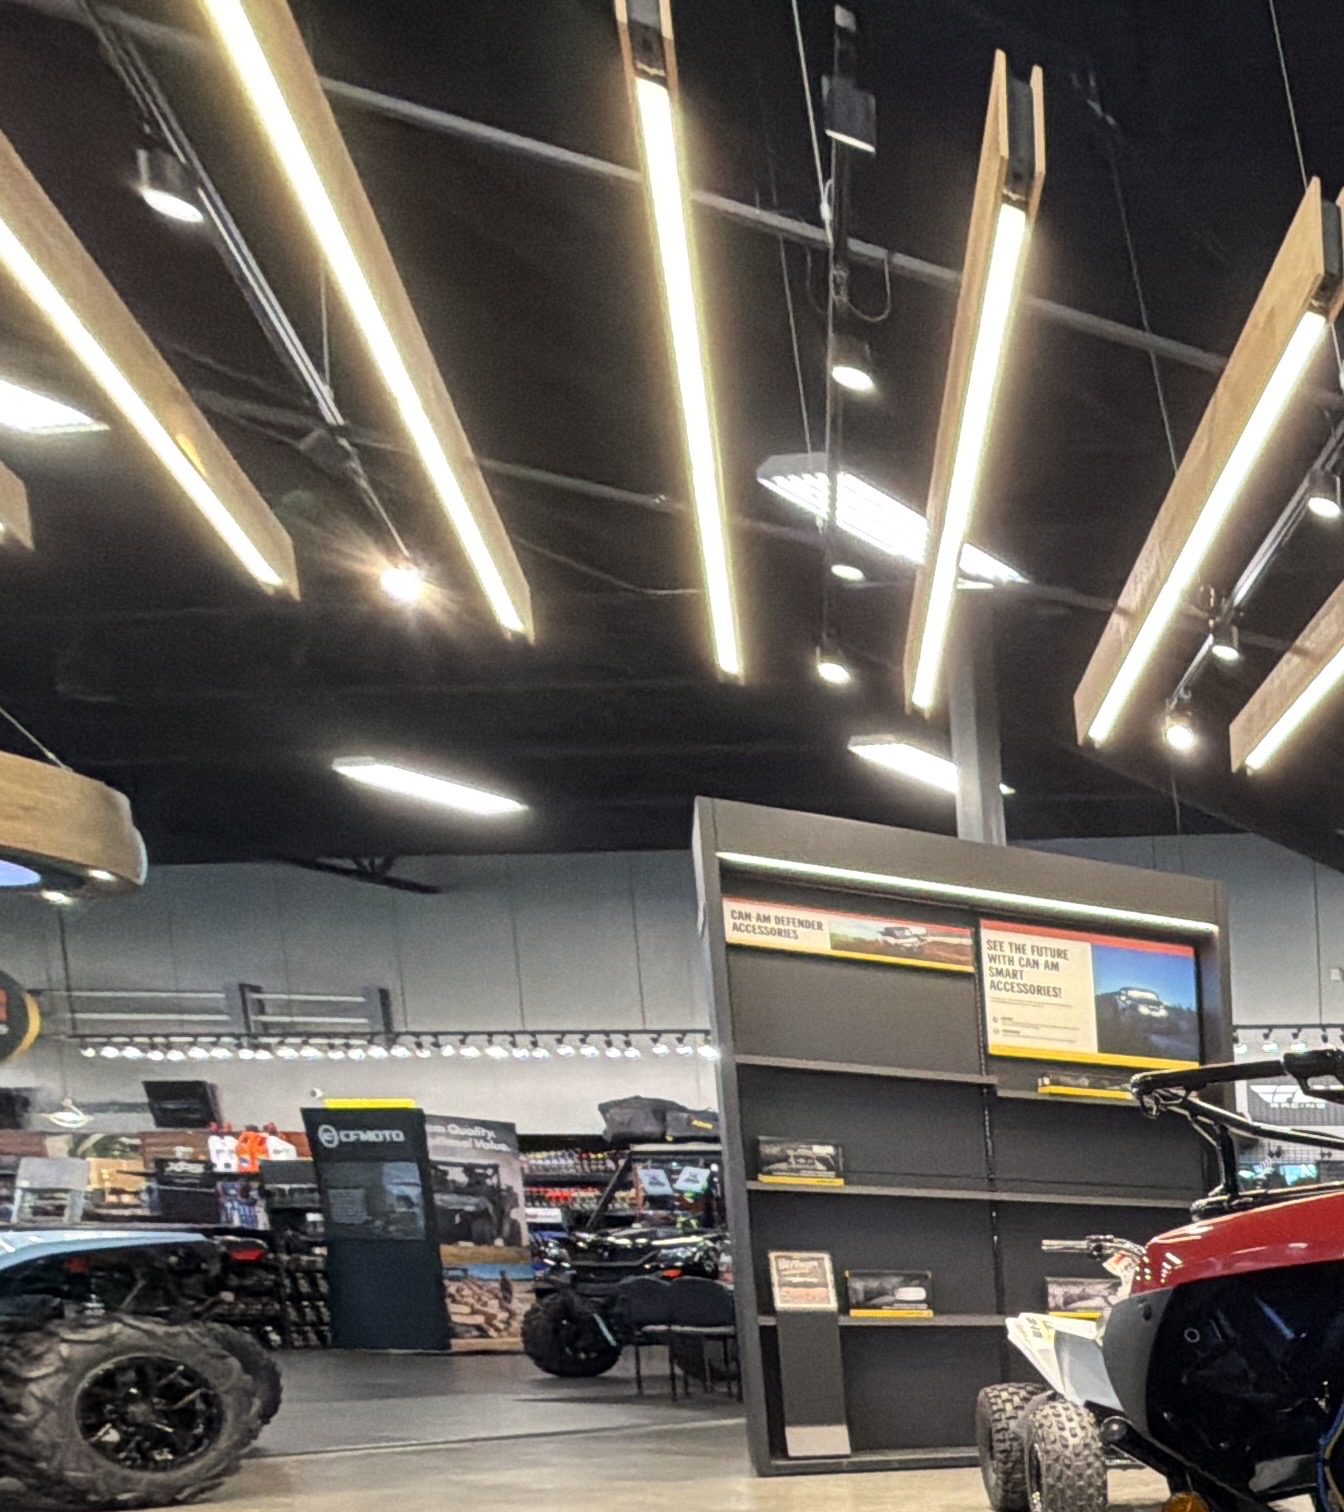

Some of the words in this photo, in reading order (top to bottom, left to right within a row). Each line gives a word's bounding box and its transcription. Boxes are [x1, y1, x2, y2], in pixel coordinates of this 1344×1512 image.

[731, 922, 800, 940] ACCESSORIES
[774, 915, 824, 931] DEFENDER
[986, 939, 1006, 953] SEE
[1007, 941, 1028, 956] THE
[1030, 944, 1070, 961] FUTURE
[987, 953, 1015, 967] WITH
[988, 966, 1024, 981] SMART
[990, 980, 1062, 999] ACCESSORIES!
[339, 1129, 405, 1143] CFMOTO
